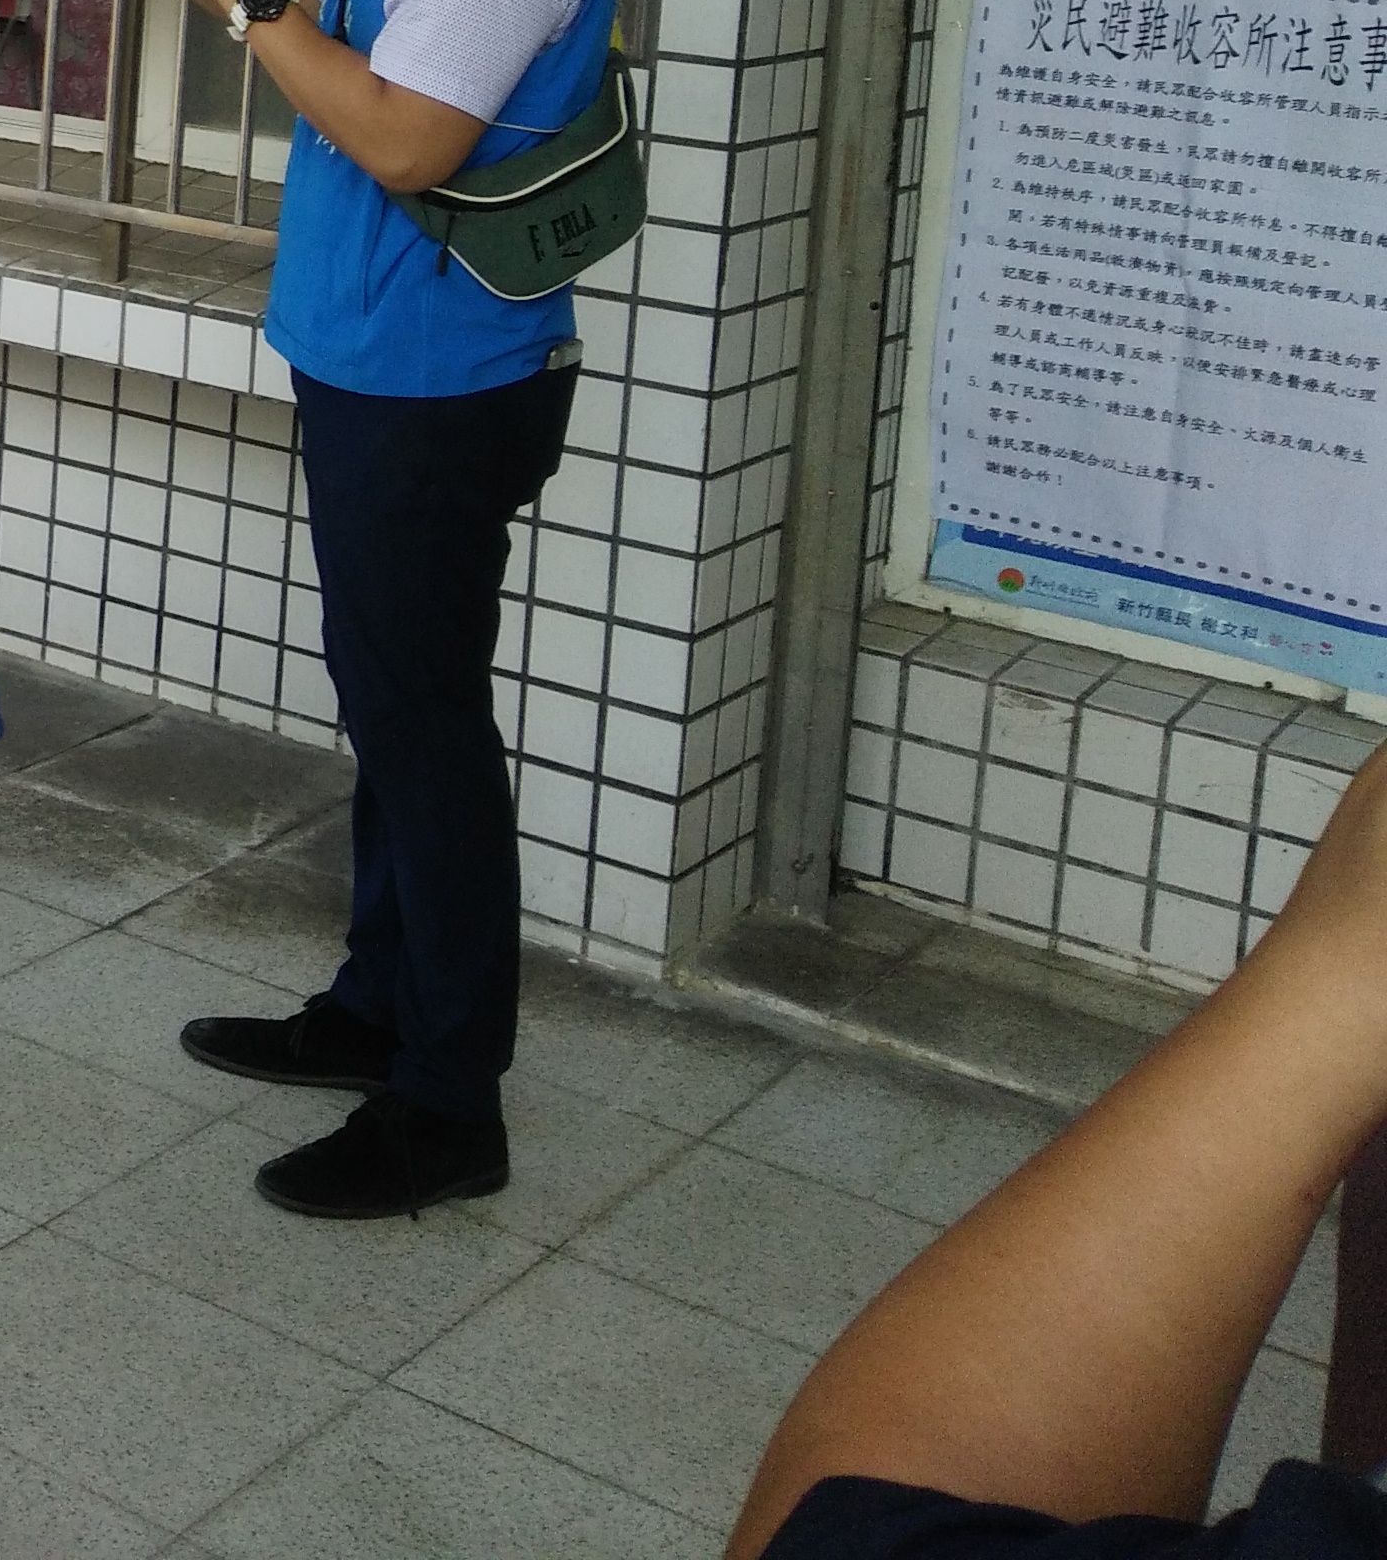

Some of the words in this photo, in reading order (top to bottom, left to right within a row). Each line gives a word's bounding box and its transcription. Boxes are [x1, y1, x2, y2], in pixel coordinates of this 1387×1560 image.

[1017, 122, 1387, 184] 為預防二度災害發生，民眾請勿擅自離開收容所
